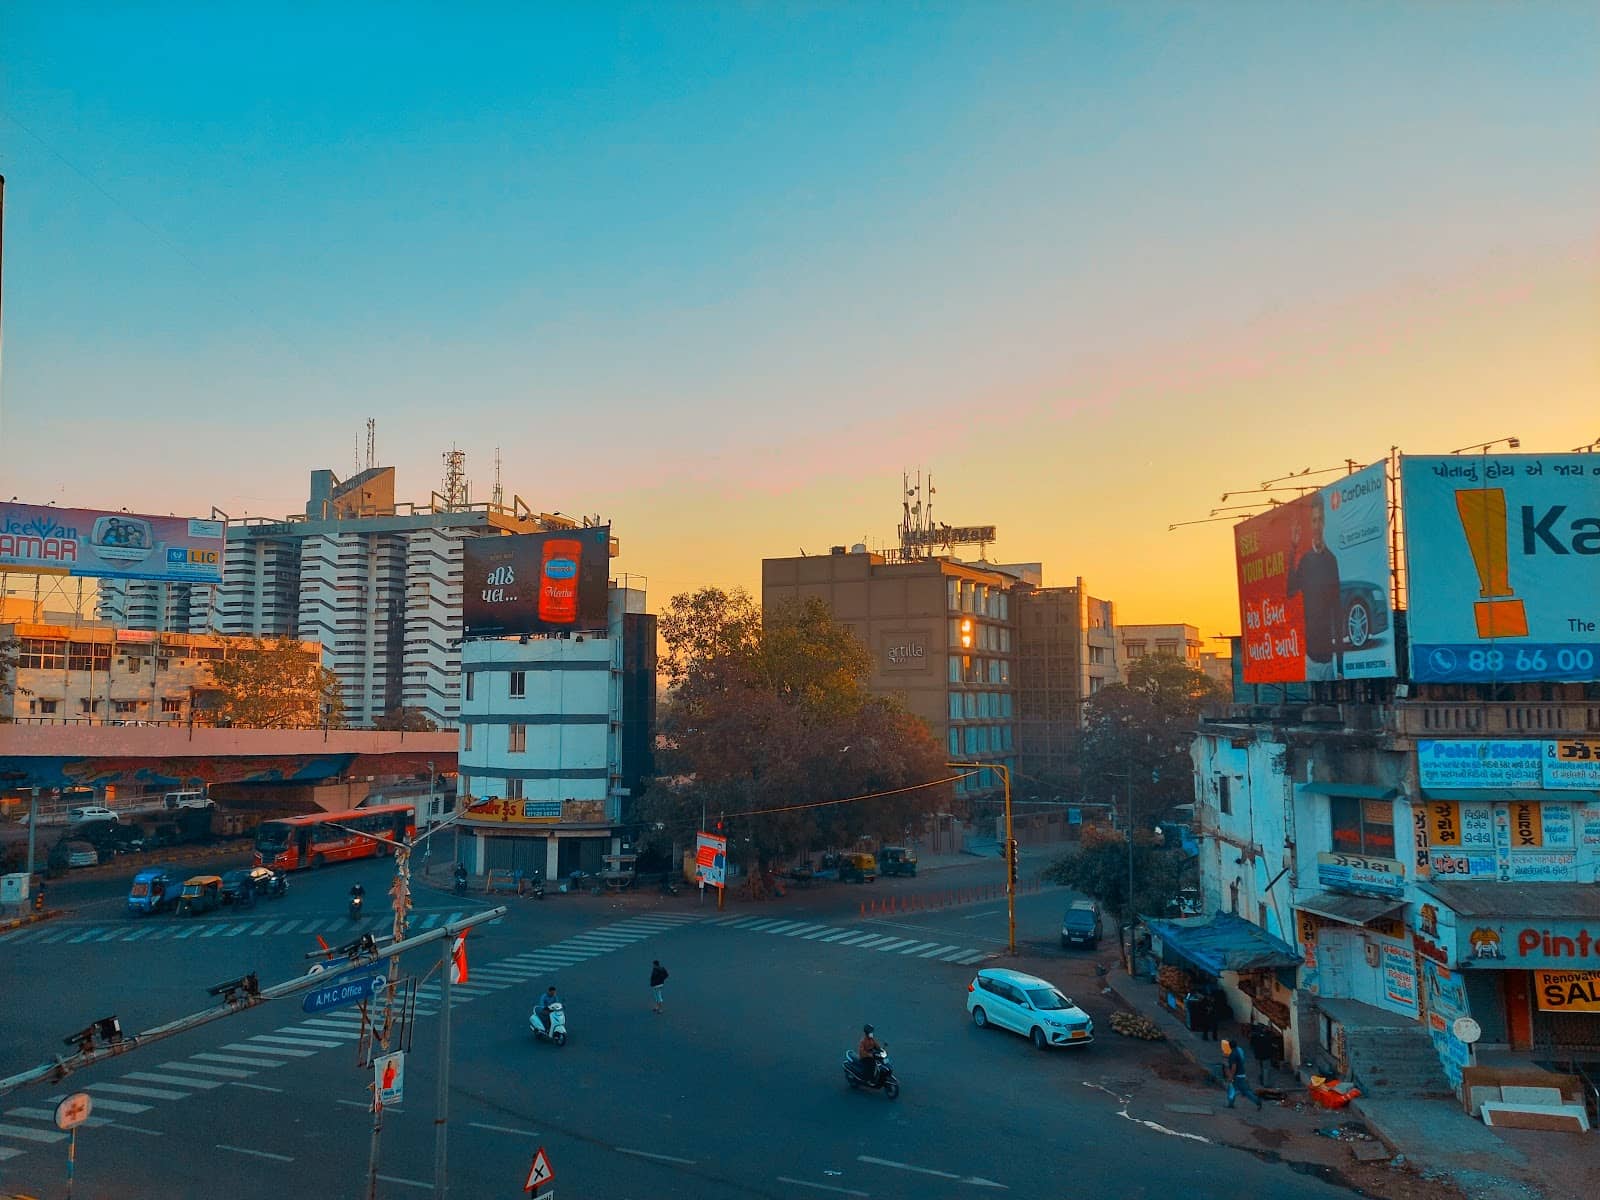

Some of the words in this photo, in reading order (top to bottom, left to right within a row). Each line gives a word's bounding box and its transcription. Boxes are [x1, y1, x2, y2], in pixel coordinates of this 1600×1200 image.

[1432, 461, 1479, 482] પોતાનું
[1486, 460, 1515, 480] હોય
[1525, 460, 1543, 476] એ
[1553, 464, 1584, 476] જાય
[1342, 479, 1382, 503] CarDekho
[191, 551, 216, 563] LIC
[1242, 559, 1264, 584] YOUR
[1265, 551, 1284, 577] CAR
[1568, 618, 1596, 632] The
[1468, 650, 1505, 672] 88
[1516, 649, 1548, 671] 66
[1557, 649, 1594, 671] 00
[1547, 744, 1557, 759] &
[1518, 804, 1535, 846] XEROX
[316, 990, 340, 1006] A.M.C.
[341, 985, 363, 998] Office
